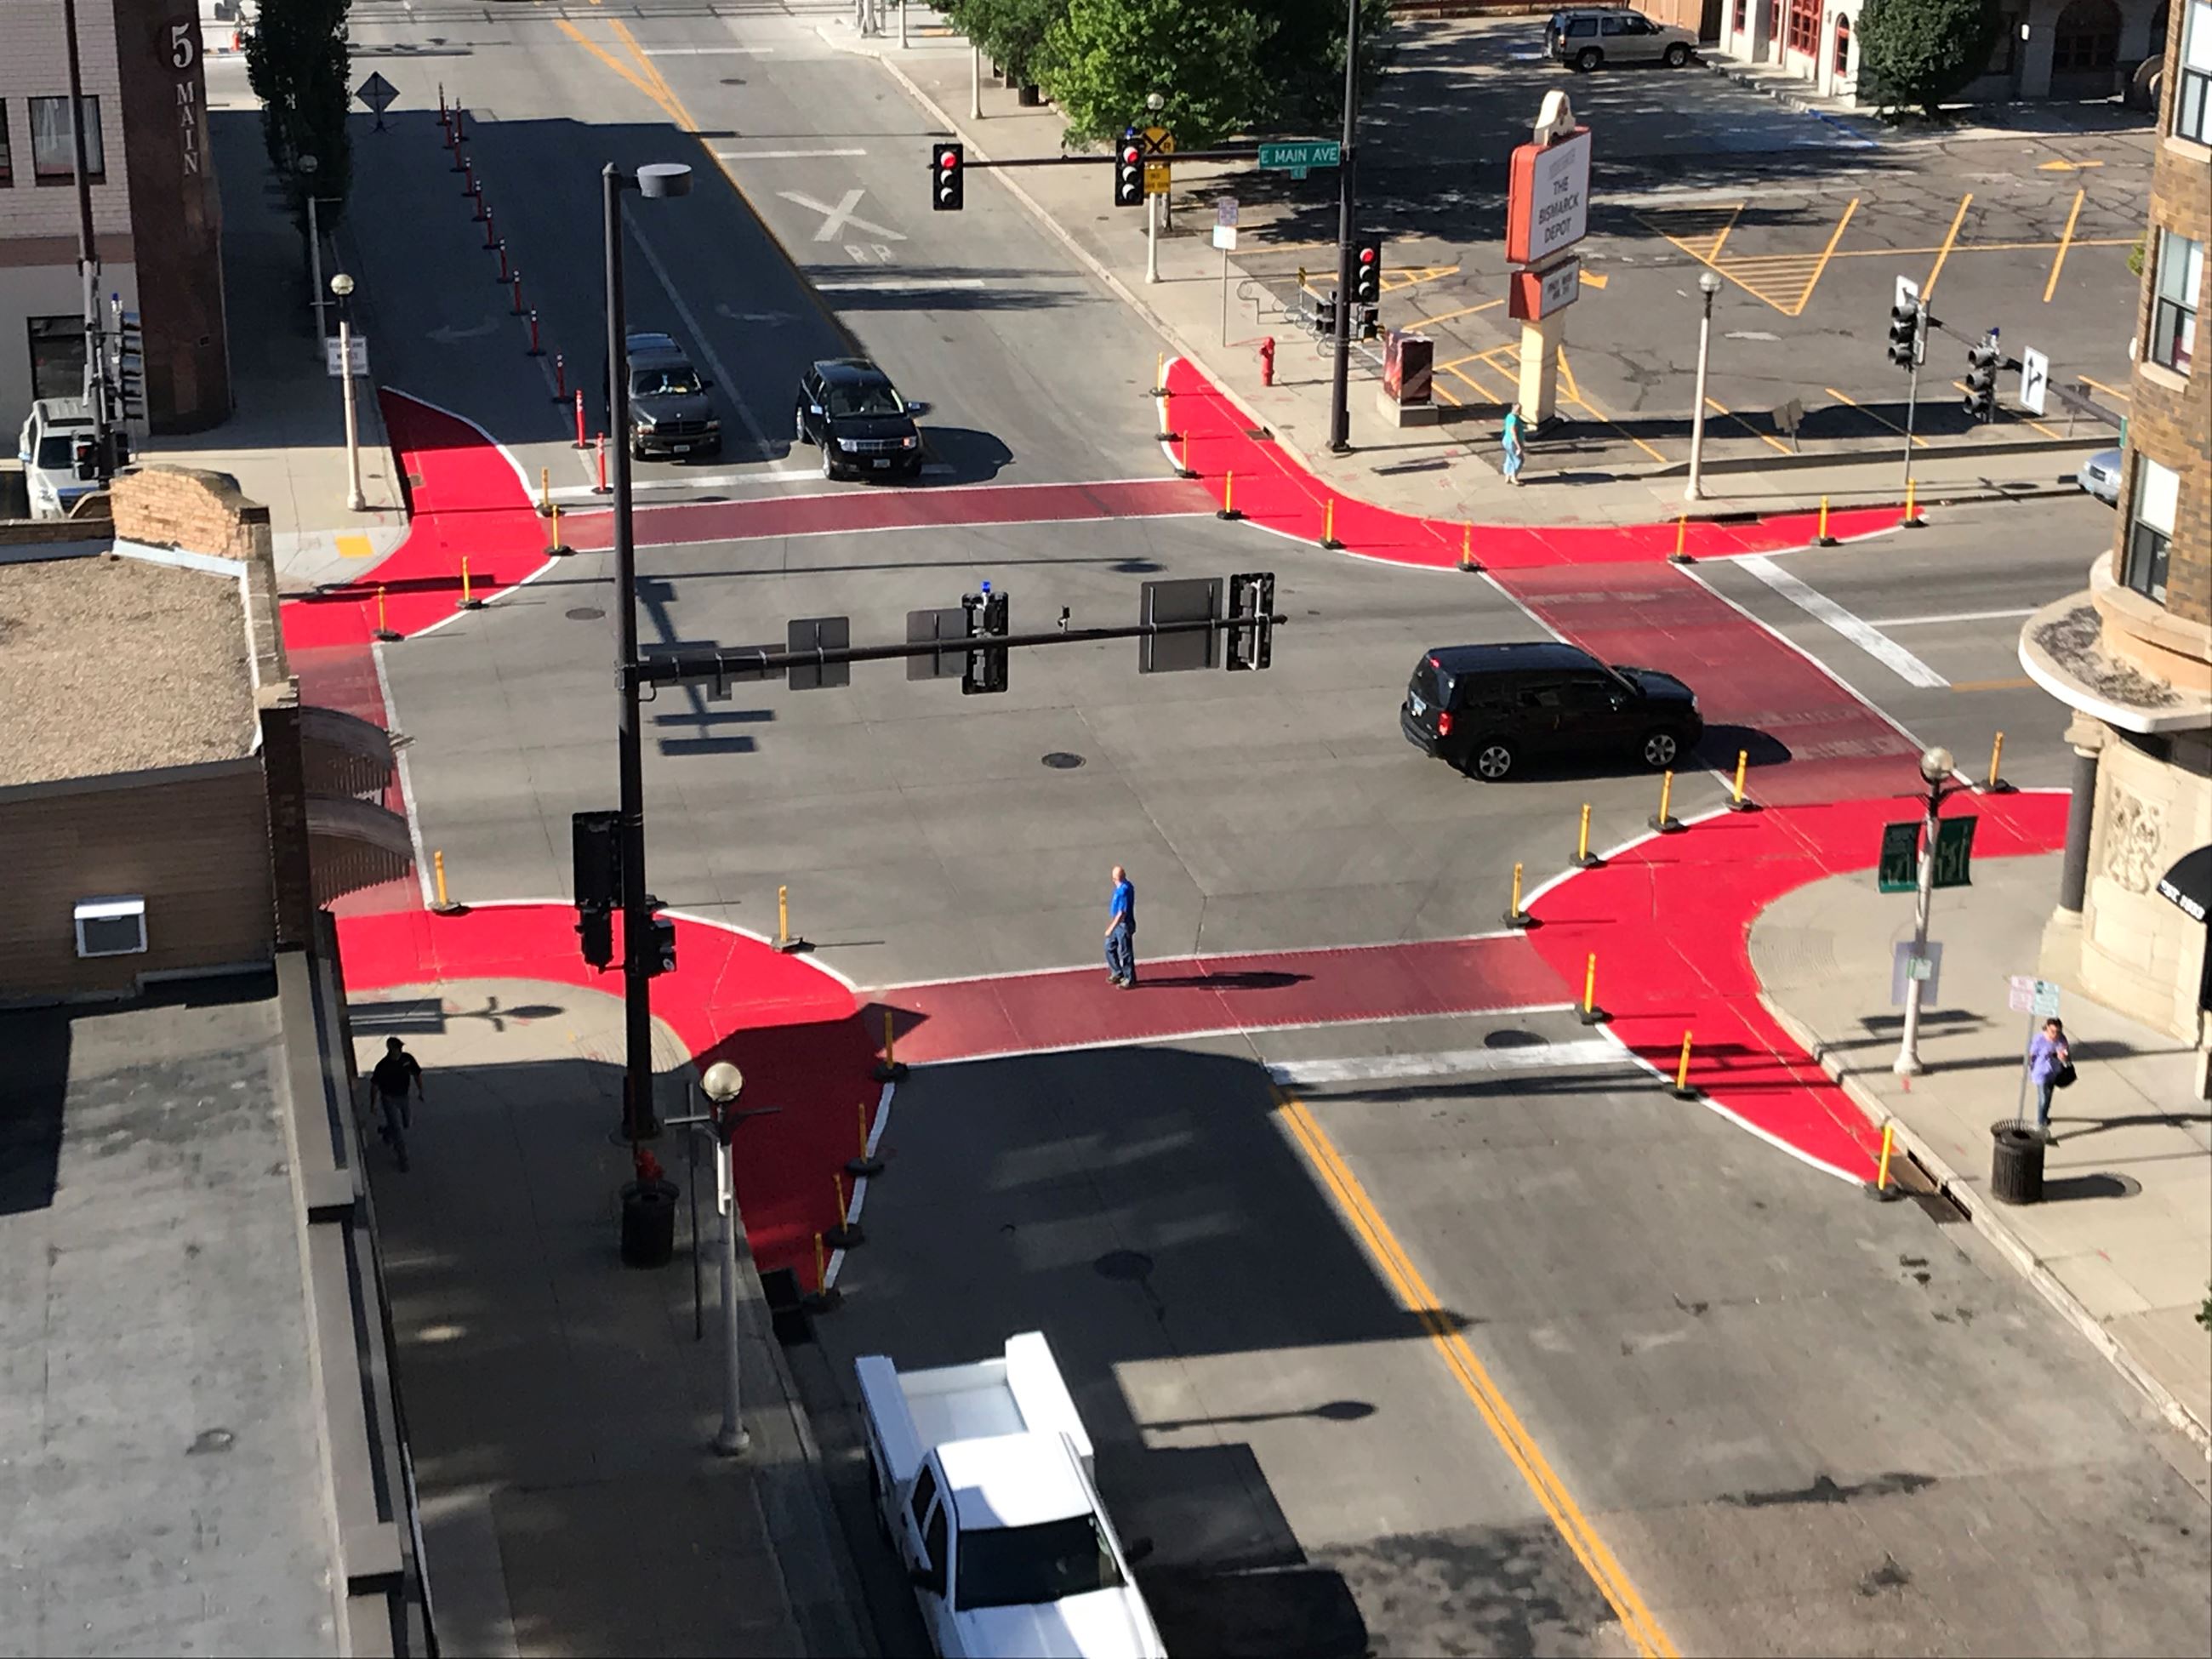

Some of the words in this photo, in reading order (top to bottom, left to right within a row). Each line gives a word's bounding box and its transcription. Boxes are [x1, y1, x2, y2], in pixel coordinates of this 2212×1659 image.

[172, 23, 194, 68] 5
[177, 82, 198, 175] MAIN
[1261, 150, 1269, 164] E
[1274, 148, 1307, 163] MAIN
[1312, 146, 1337, 162] AVE
[1553, 175, 1569, 196] THE
[1538, 191, 1579, 225] BISMARCK
[1544, 216, 1571, 244] DEPOT
